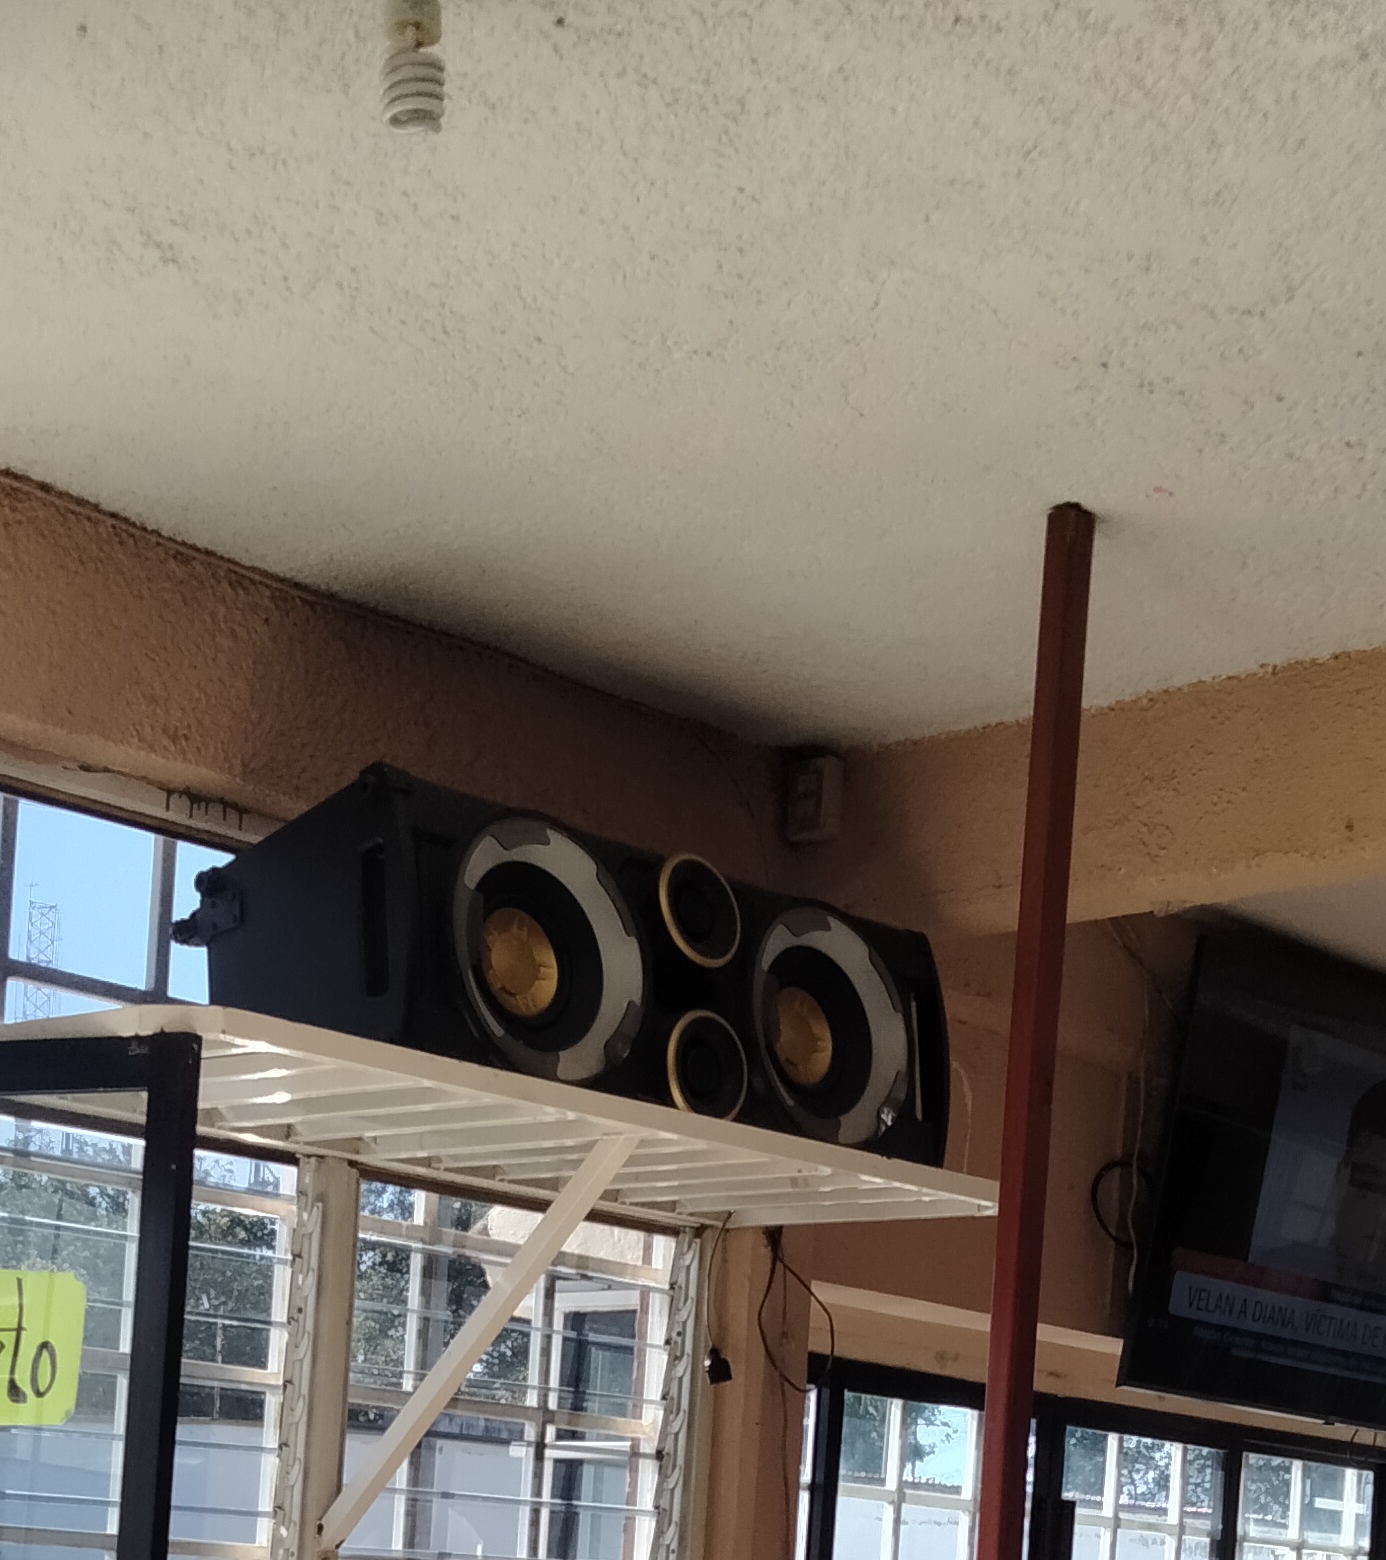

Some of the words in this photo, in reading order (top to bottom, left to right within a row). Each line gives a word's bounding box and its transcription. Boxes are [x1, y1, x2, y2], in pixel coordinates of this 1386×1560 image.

[1187, 1286, 1234, 1318] VELAN
[1237, 1298, 1248, 1320] A
[1252, 1300, 1299, 1333] DIANA,
[1304, 1309, 1358, 1344] VÍCTIMA
